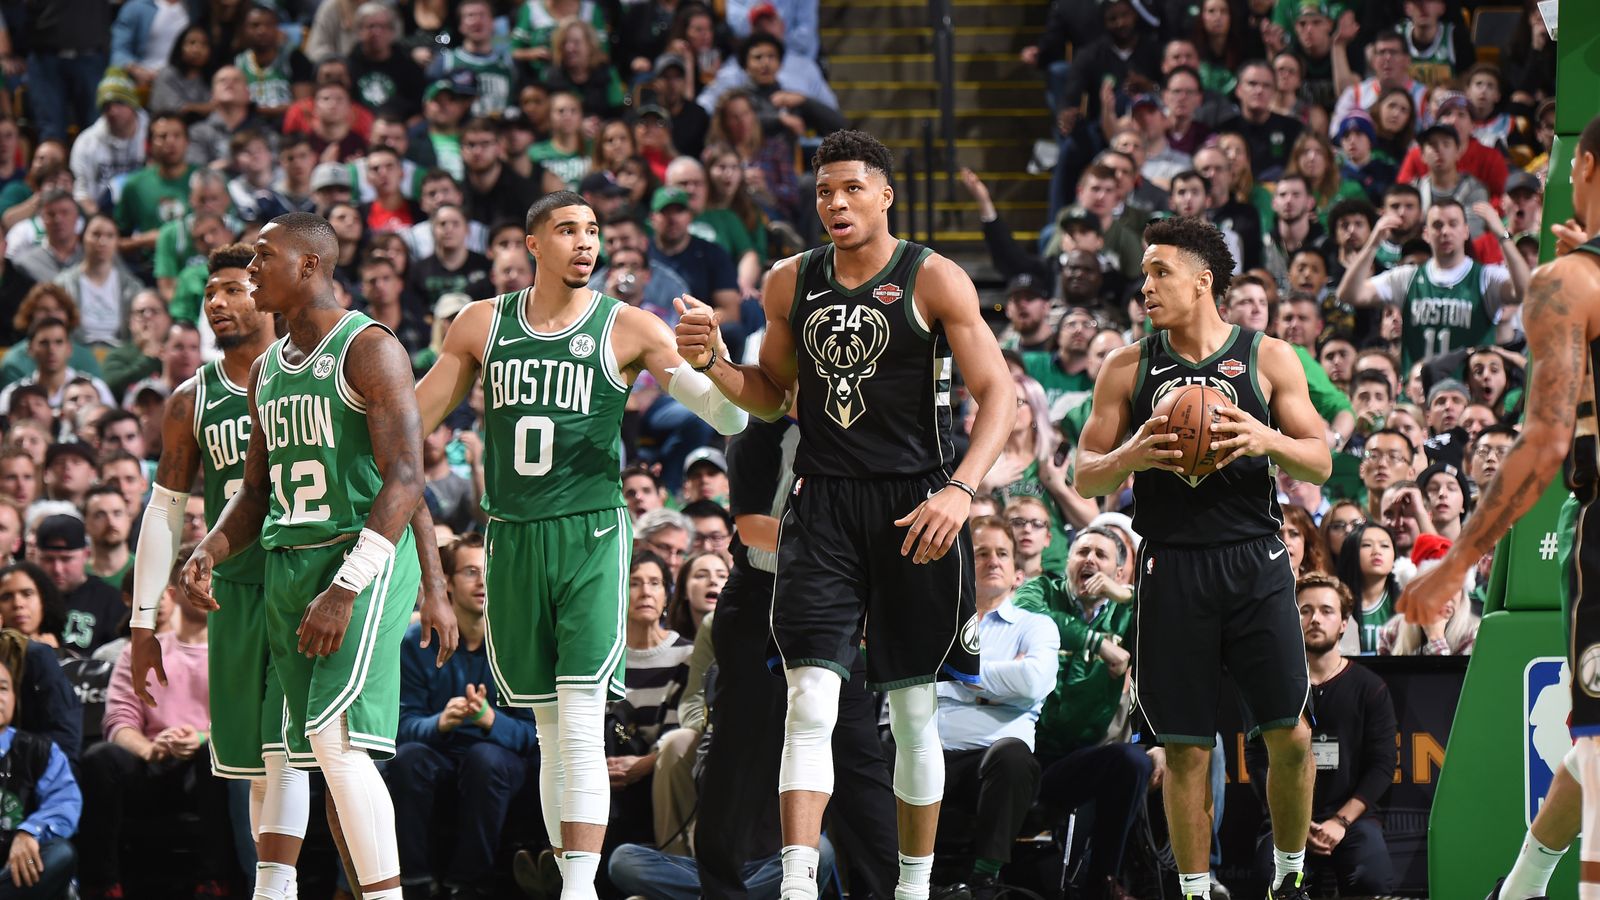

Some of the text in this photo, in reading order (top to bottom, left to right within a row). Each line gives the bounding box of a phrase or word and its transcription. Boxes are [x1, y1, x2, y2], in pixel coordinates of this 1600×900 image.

[832, 305, 861, 331] 34
[1411, 298, 1473, 328] BOSTON
[1423, 327, 1451, 358] 11
[490, 358, 595, 415] BOSTON
[204, 415, 251, 471] BOS
[514, 415, 555, 477] 0
[269, 459, 332, 523] 12
